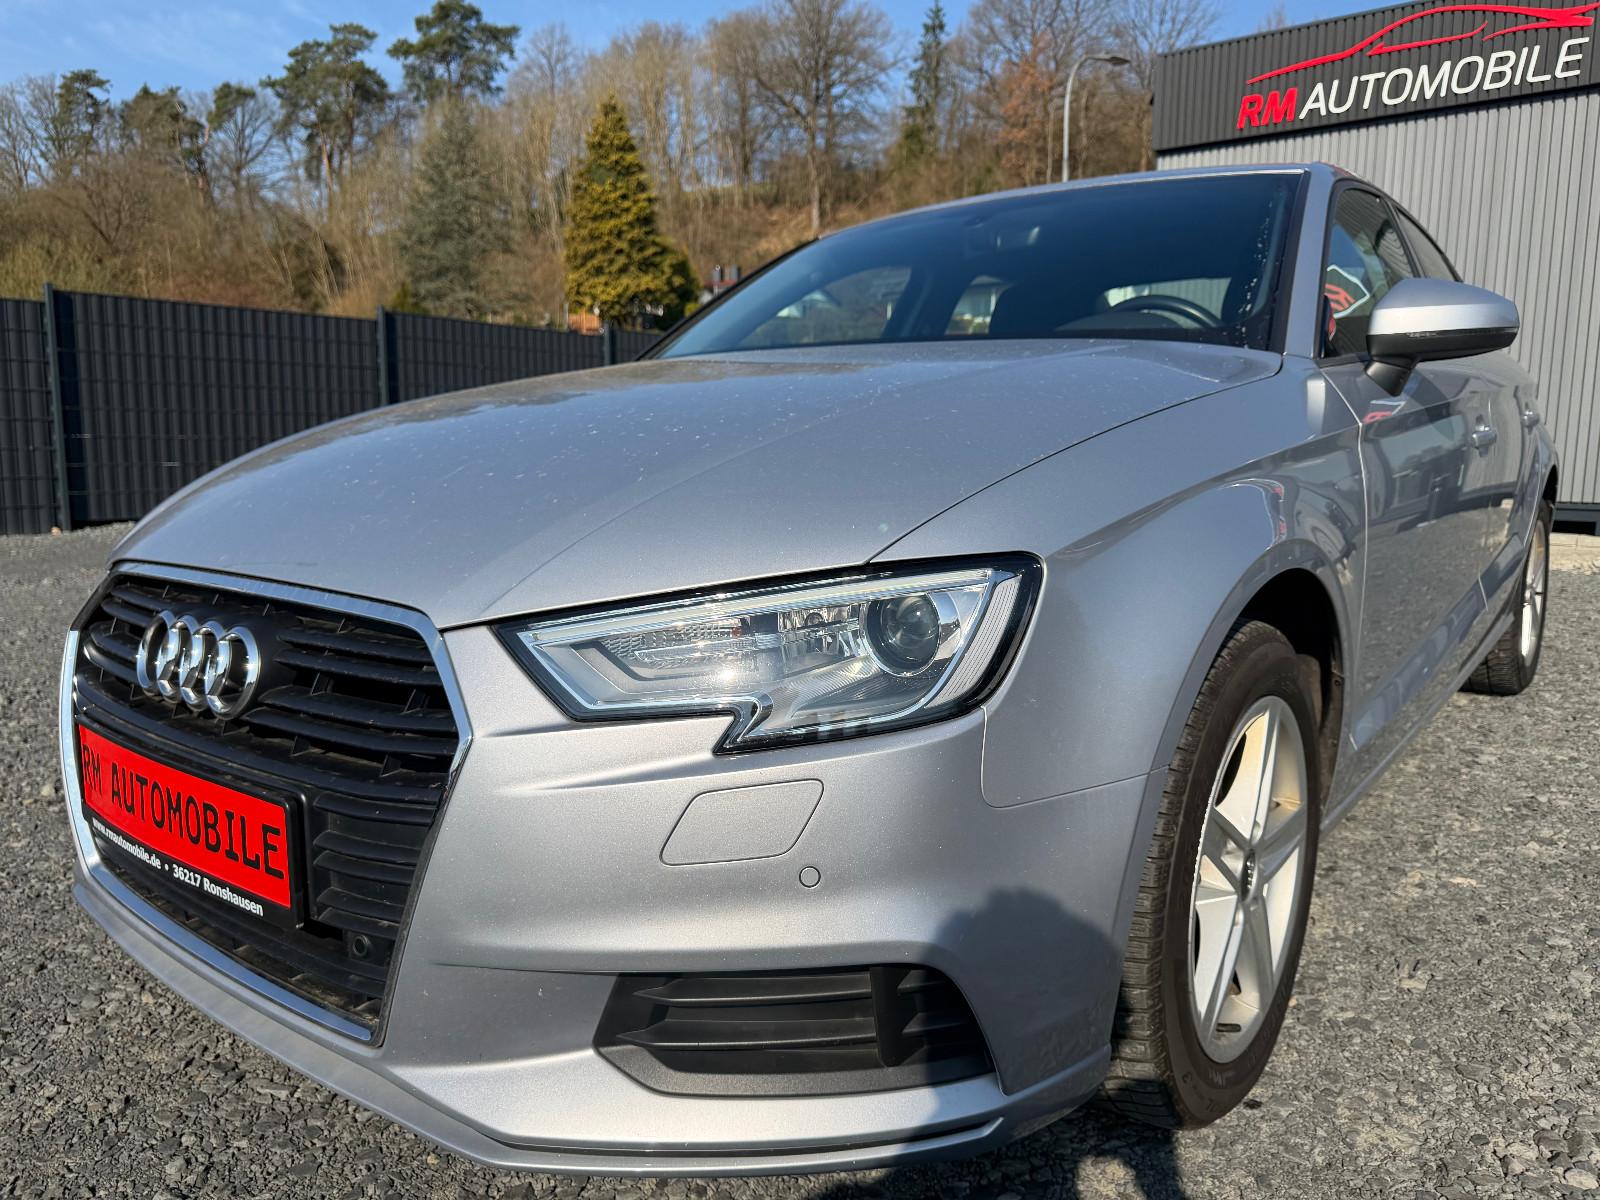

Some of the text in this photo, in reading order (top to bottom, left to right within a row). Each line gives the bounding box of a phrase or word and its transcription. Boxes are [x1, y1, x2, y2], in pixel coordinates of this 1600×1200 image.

[82, 744, 285, 880] RM AUTOMOBILE
[172, 863, 202, 888] 36217
[203, 877, 264, 917] Ronshausen
